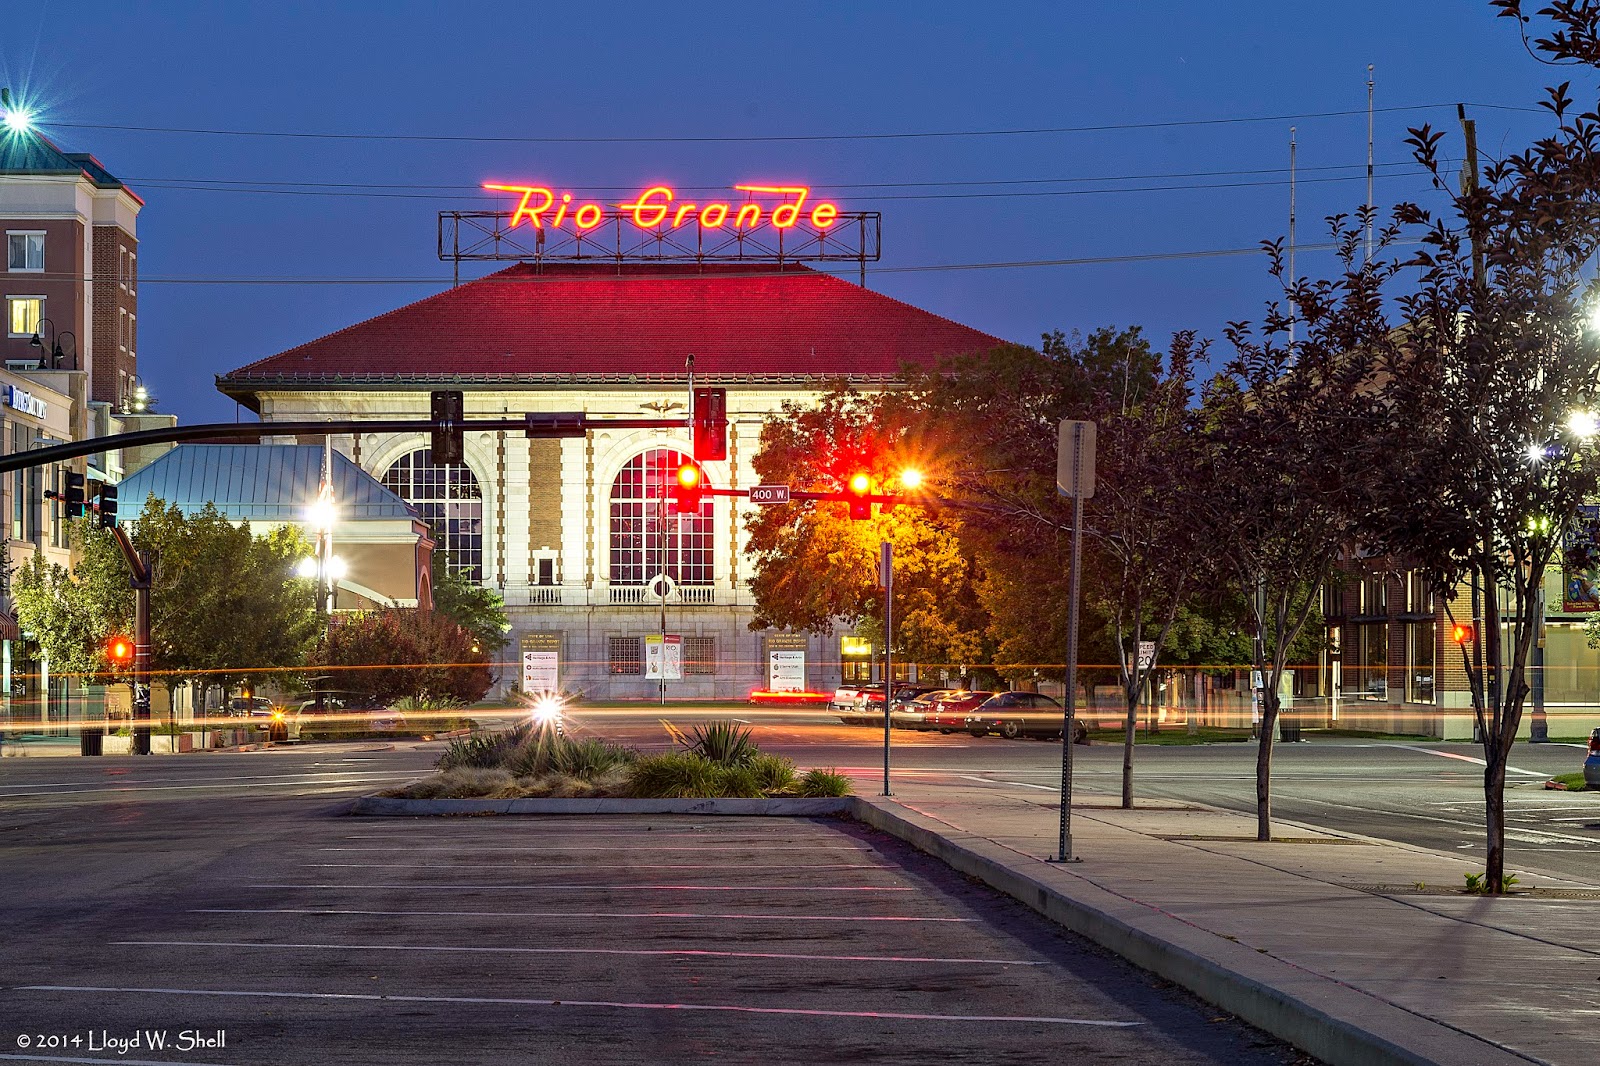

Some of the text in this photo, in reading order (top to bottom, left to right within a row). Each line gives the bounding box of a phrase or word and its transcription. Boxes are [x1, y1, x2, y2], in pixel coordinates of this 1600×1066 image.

[481, 183, 838, 229] Rio Grande
[752, 490, 787, 499] 400 W.
[1138, 655, 1151, 666] 20
